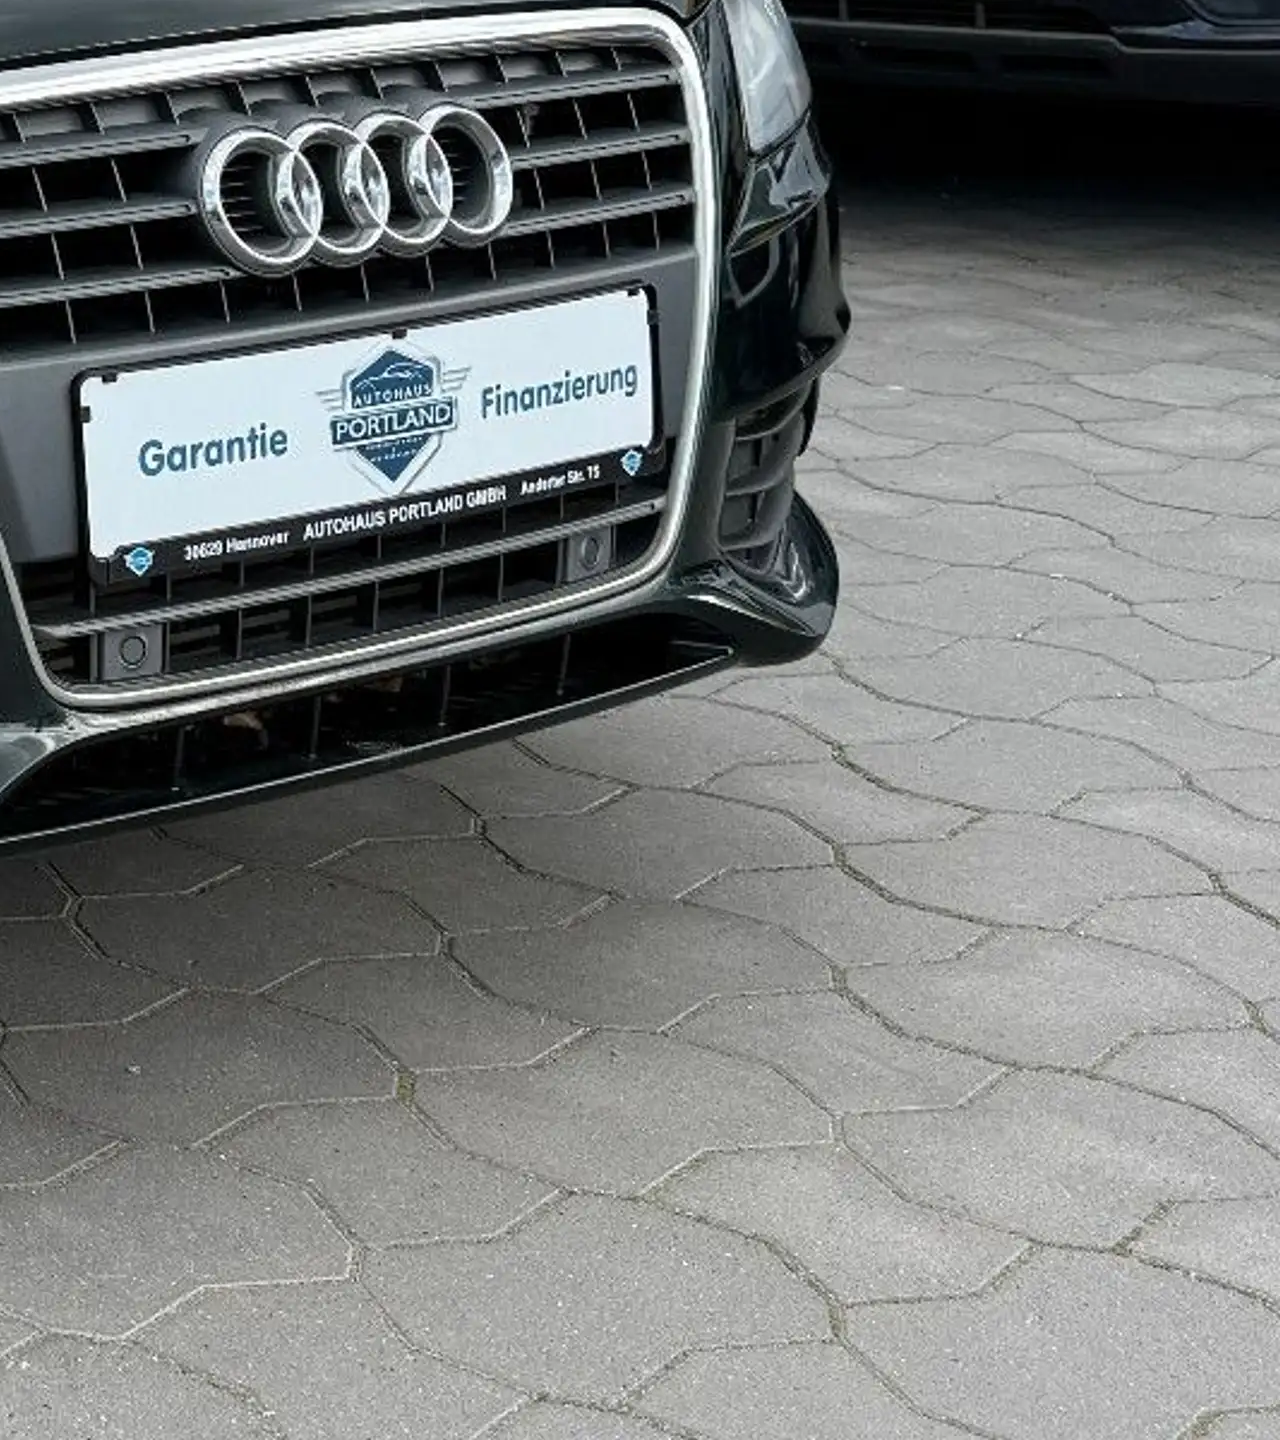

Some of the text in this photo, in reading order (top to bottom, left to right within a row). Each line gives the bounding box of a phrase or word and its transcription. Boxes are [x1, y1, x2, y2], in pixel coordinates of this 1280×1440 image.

[353, 383, 432, 408] AUTOHAUS
[480, 361, 639, 420] Finanzierung
[138, 422, 289, 478] Garantie
[336, 403, 451, 441] PORTLAND
[302, 510, 386, 541] AUTOHAUS
[389, 493, 464, 525] PORTLAND
[466, 485, 507, 508] GMBH
